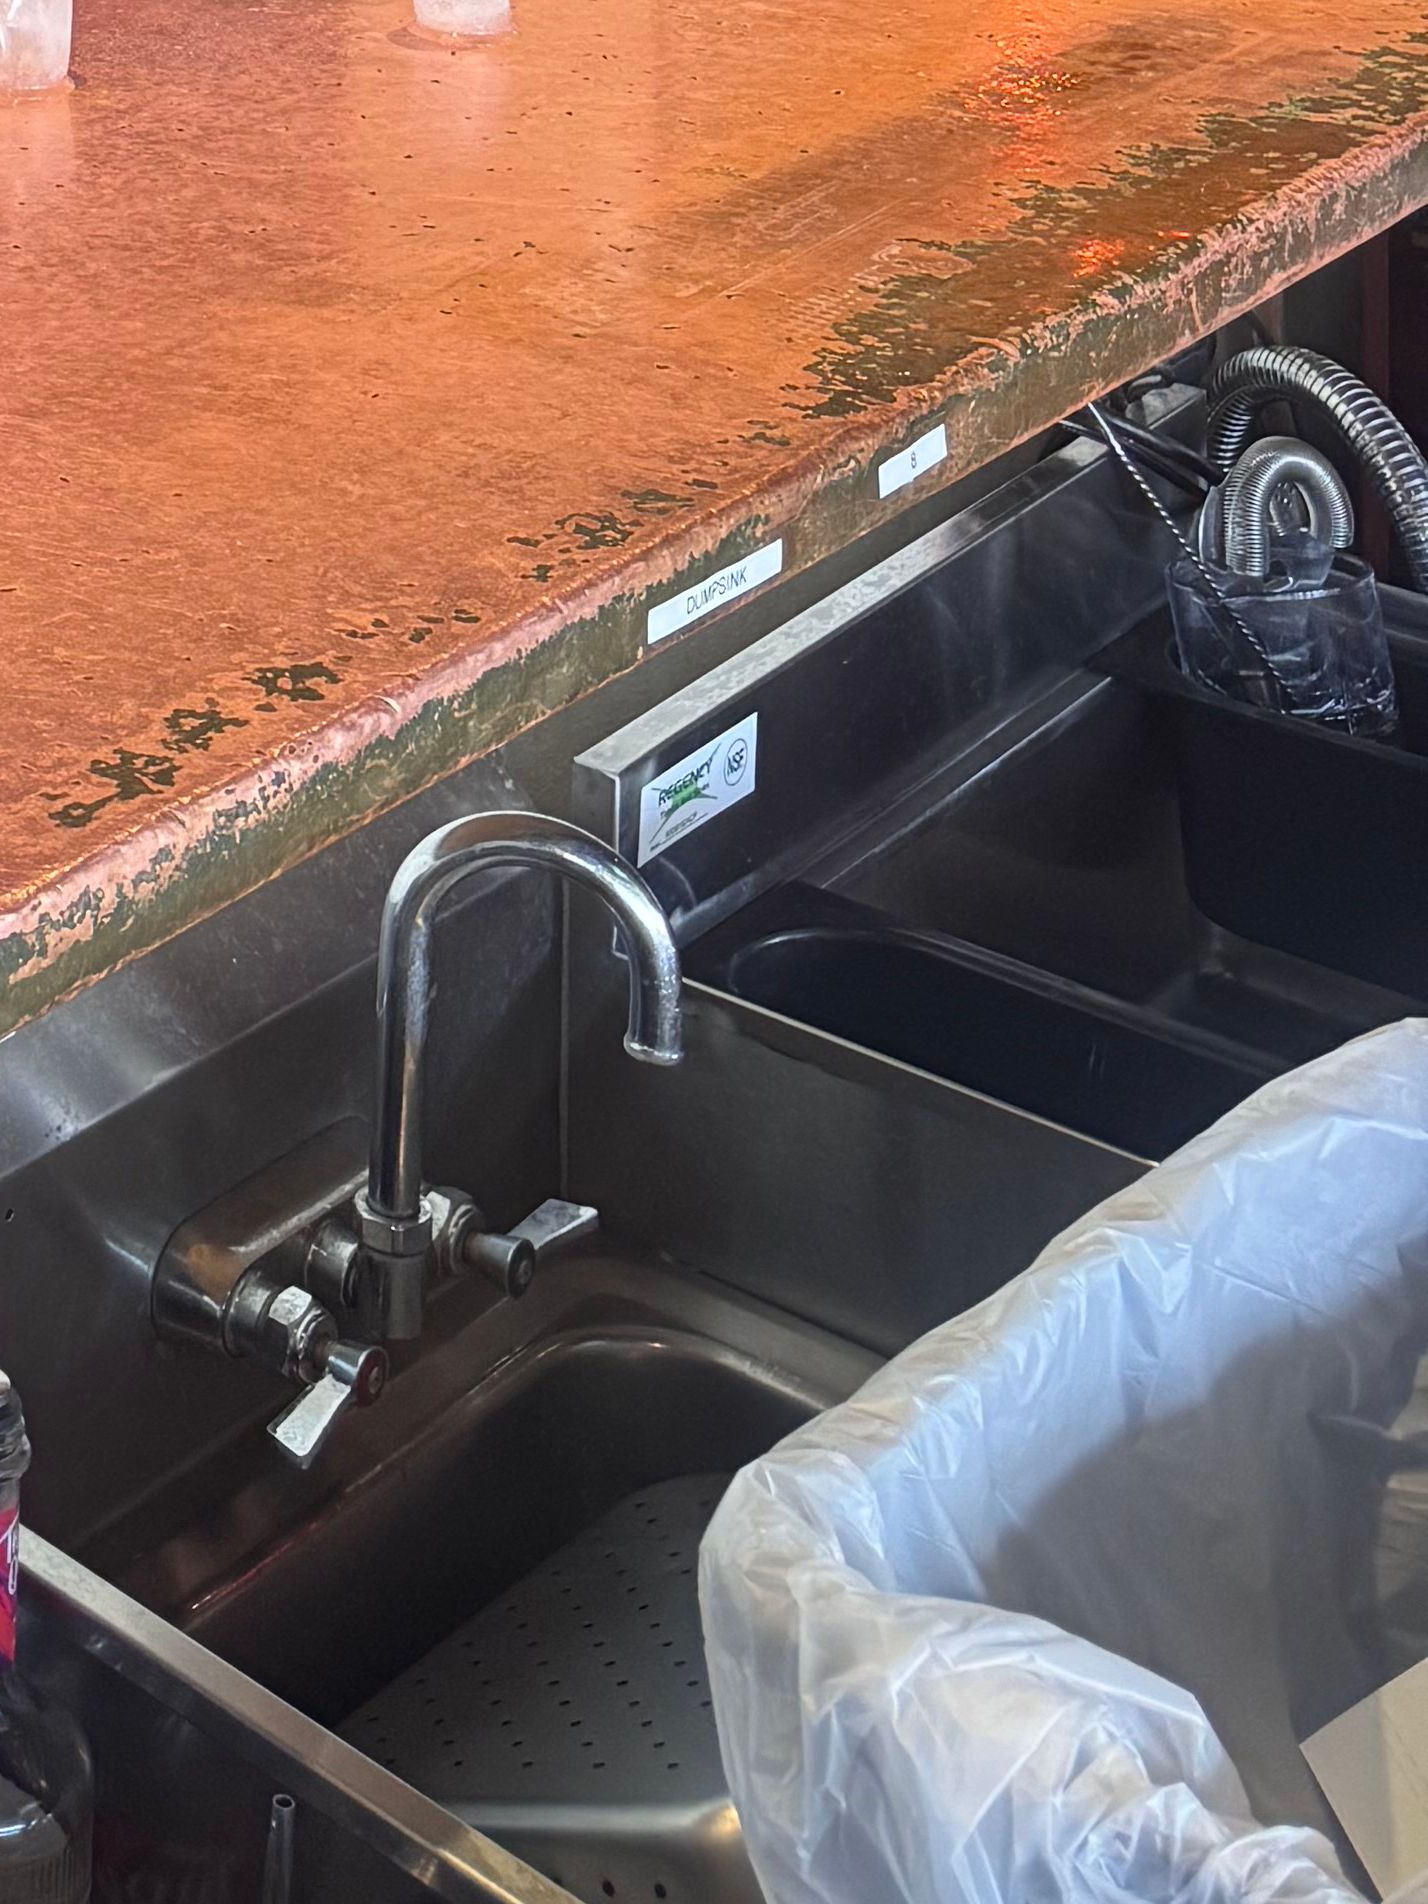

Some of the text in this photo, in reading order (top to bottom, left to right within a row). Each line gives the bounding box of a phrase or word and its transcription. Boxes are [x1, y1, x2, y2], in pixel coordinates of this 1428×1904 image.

[911, 451, 918, 469] 8
[686, 566, 747, 614] DUMPSINK
[658, 757, 713, 806] REGENCY
